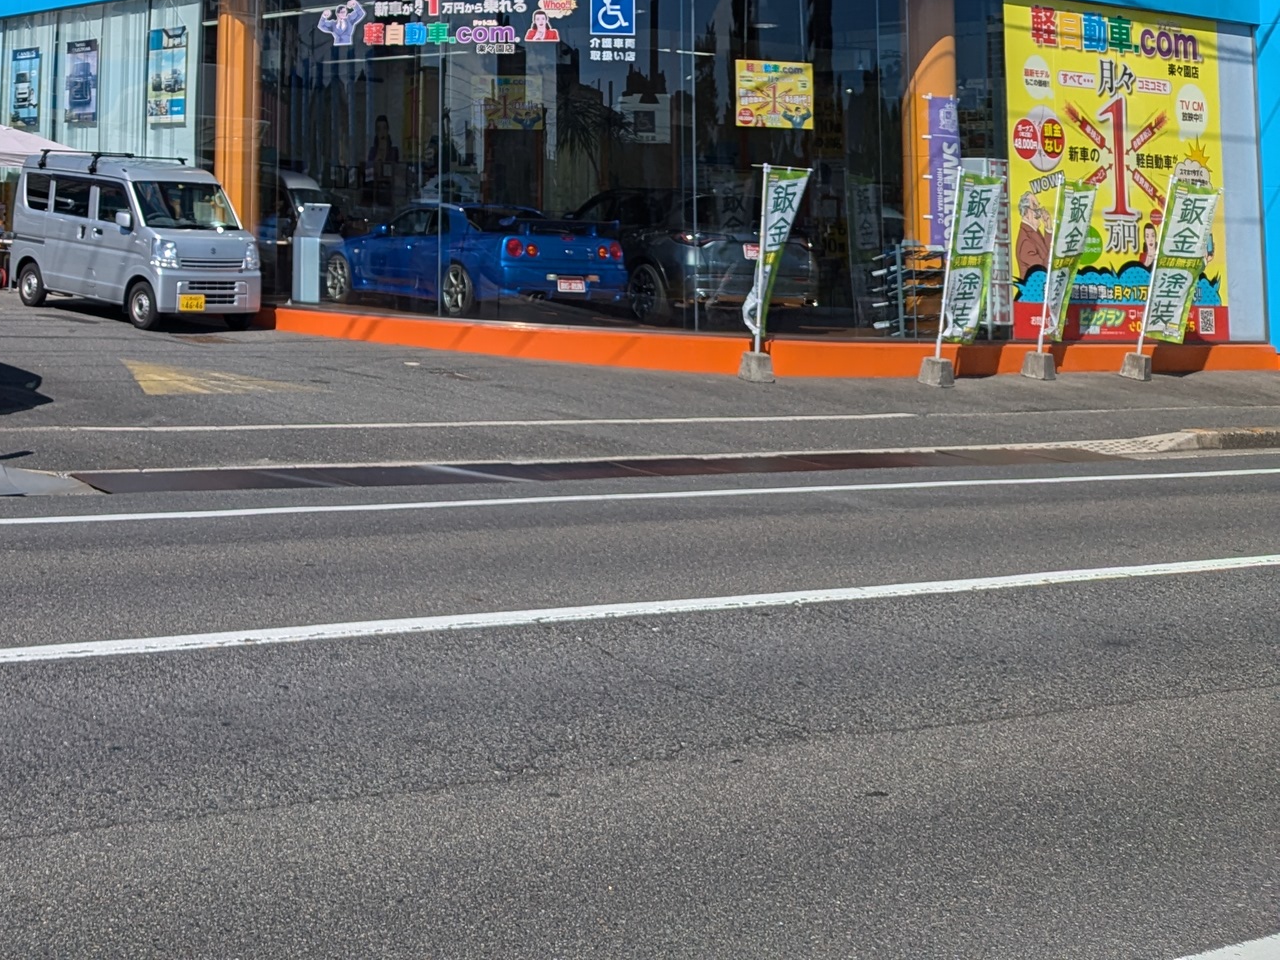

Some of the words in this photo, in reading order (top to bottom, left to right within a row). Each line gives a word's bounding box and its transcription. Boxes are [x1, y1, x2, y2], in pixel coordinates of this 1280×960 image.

[1099, 59, 1135, 95] 月々
[1044, 123, 1062, 138] 頭金
[1044, 138, 1062, 153] なし
[1068, 146, 1100, 162] 新車の
[1169, 198, 1209, 254] 鈑金
